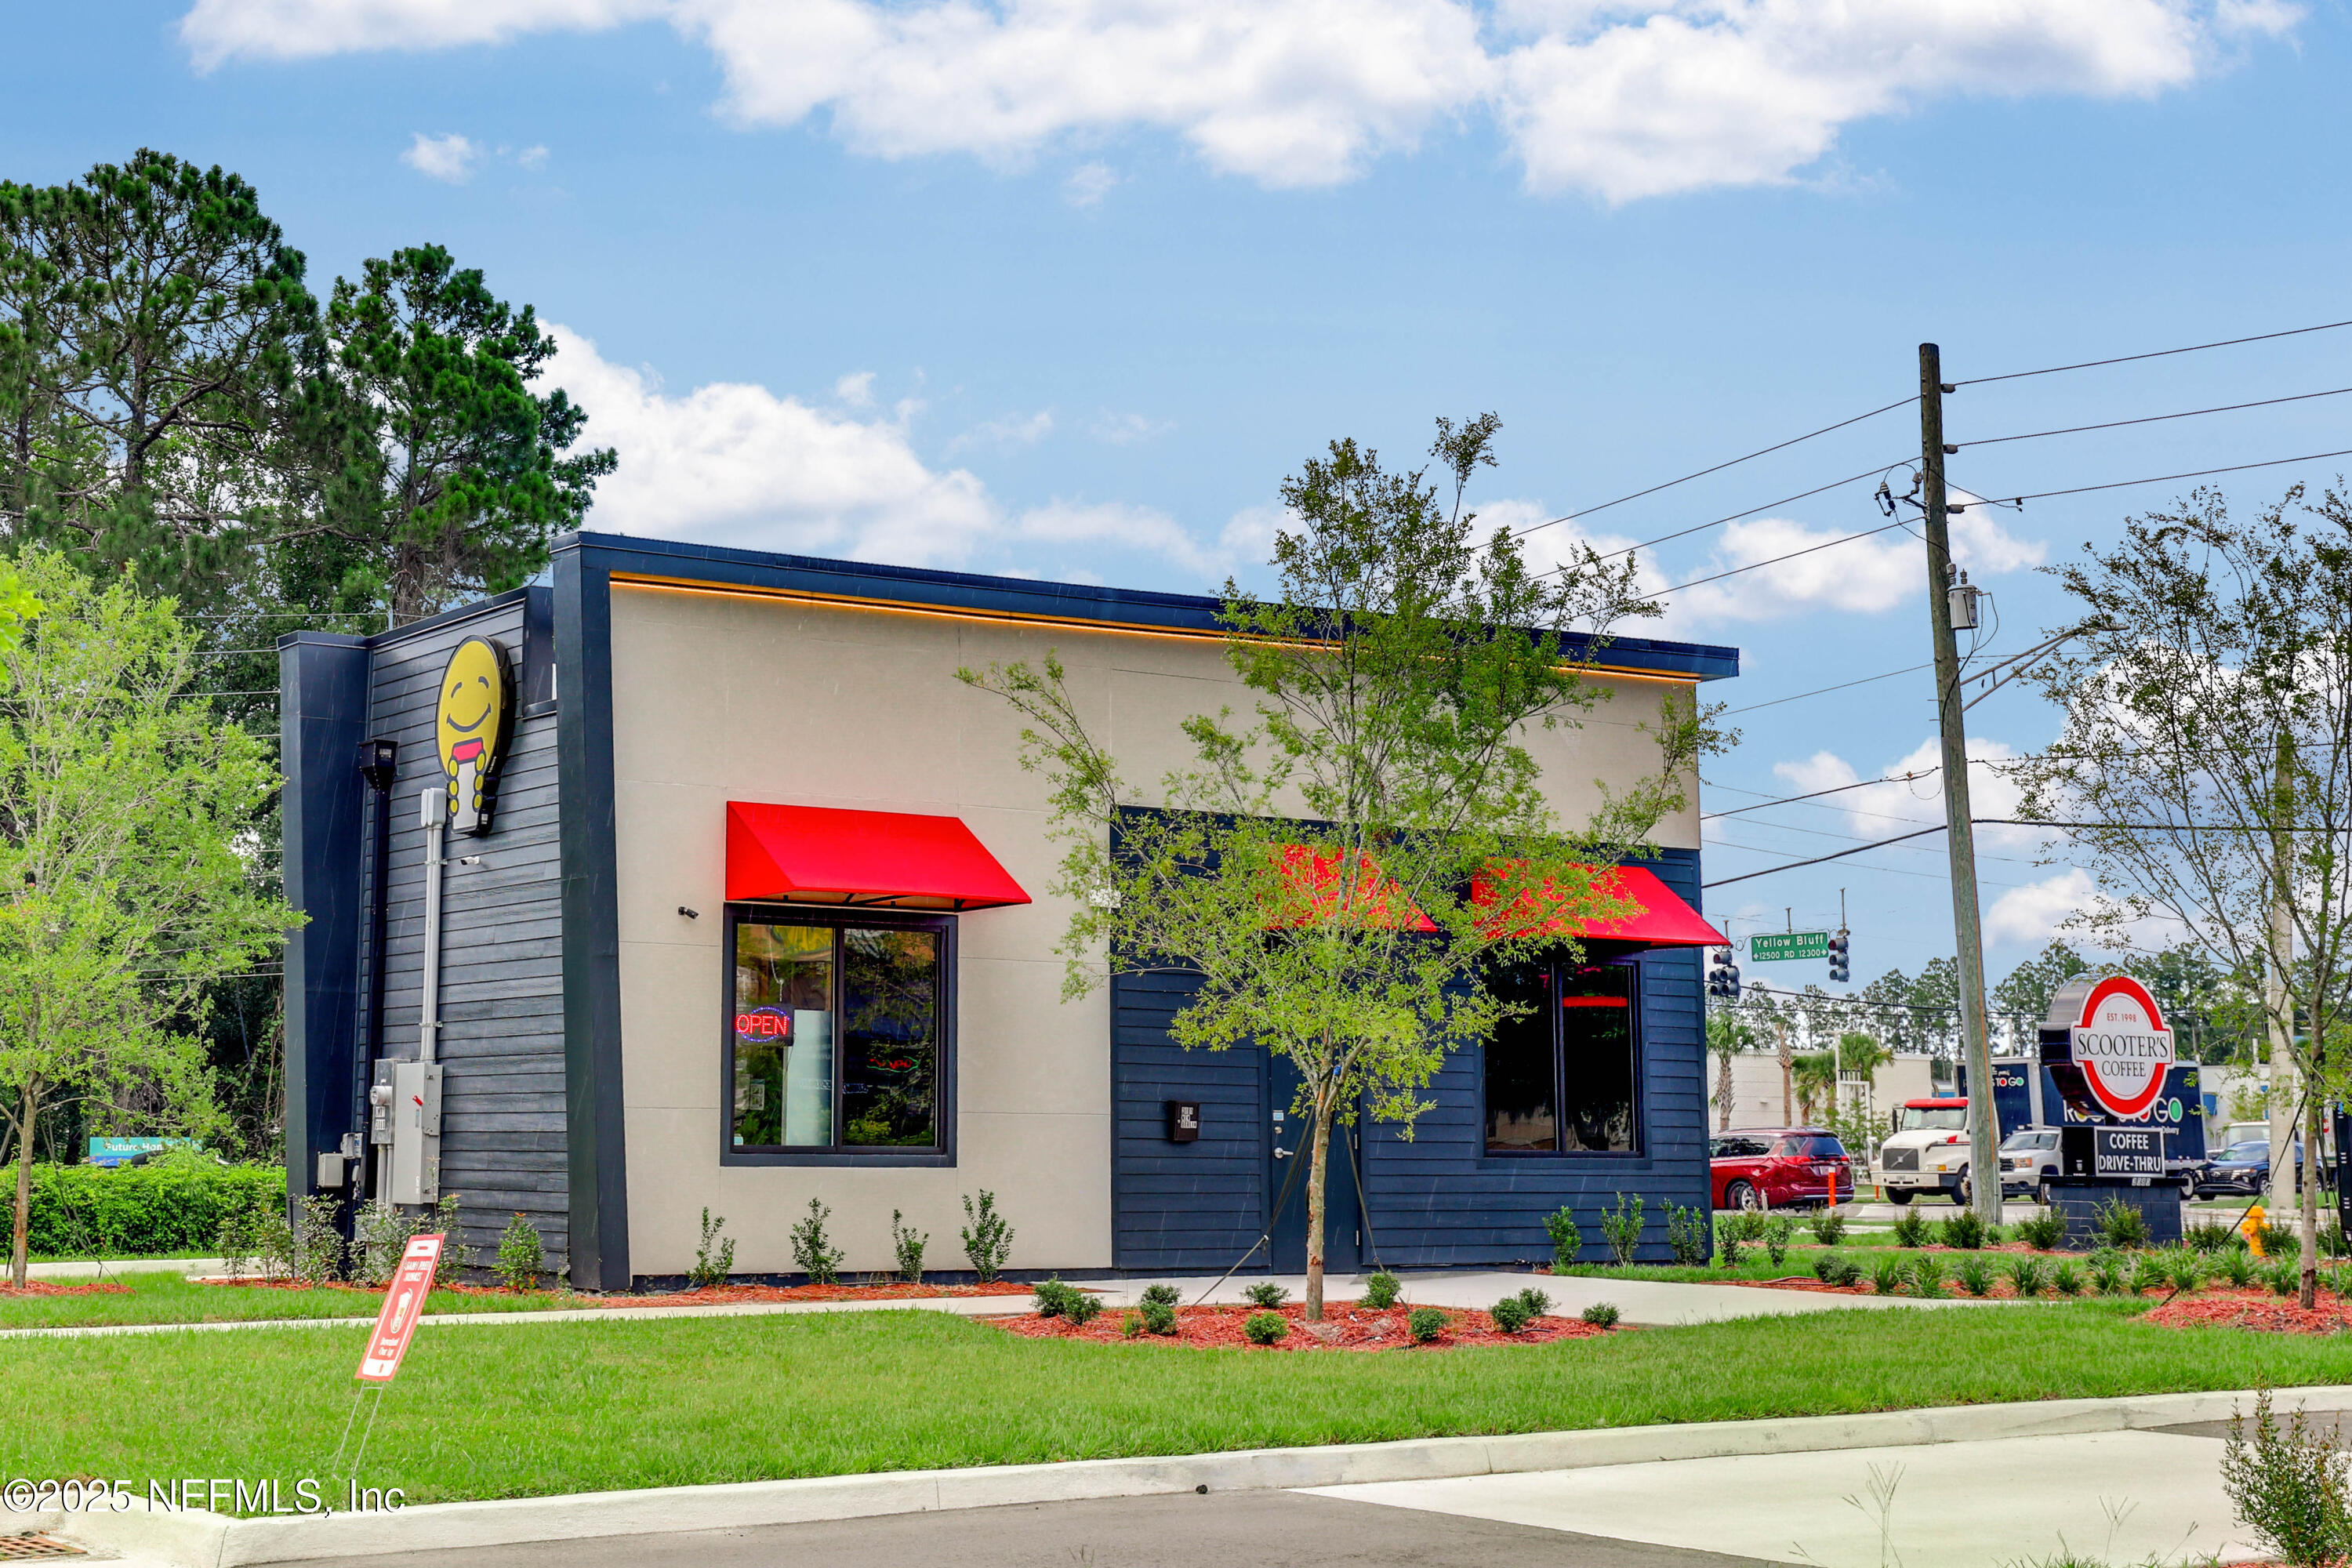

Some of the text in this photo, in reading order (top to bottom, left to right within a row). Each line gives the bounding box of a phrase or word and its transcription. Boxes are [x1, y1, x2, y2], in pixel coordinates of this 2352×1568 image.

[1755, 935, 1824, 948] Yellow Bluff
[1759, 949, 1820, 960] 12500 RD 12300
[735, 1014, 788, 1035] OPEN
[2107, 1013, 2137, 1022] EST. 1998
[2078, 1033, 2168, 1058] SCOOTER'S
[2102, 1061, 2146, 1076] COFFEE
[2008, 1076, 2024, 1087] GO
[2154, 1098, 2183, 1123] GO
[2110, 1134, 2149, 1150] COFFEE
[2099, 1155, 2161, 1172] DRIVE-THRU
